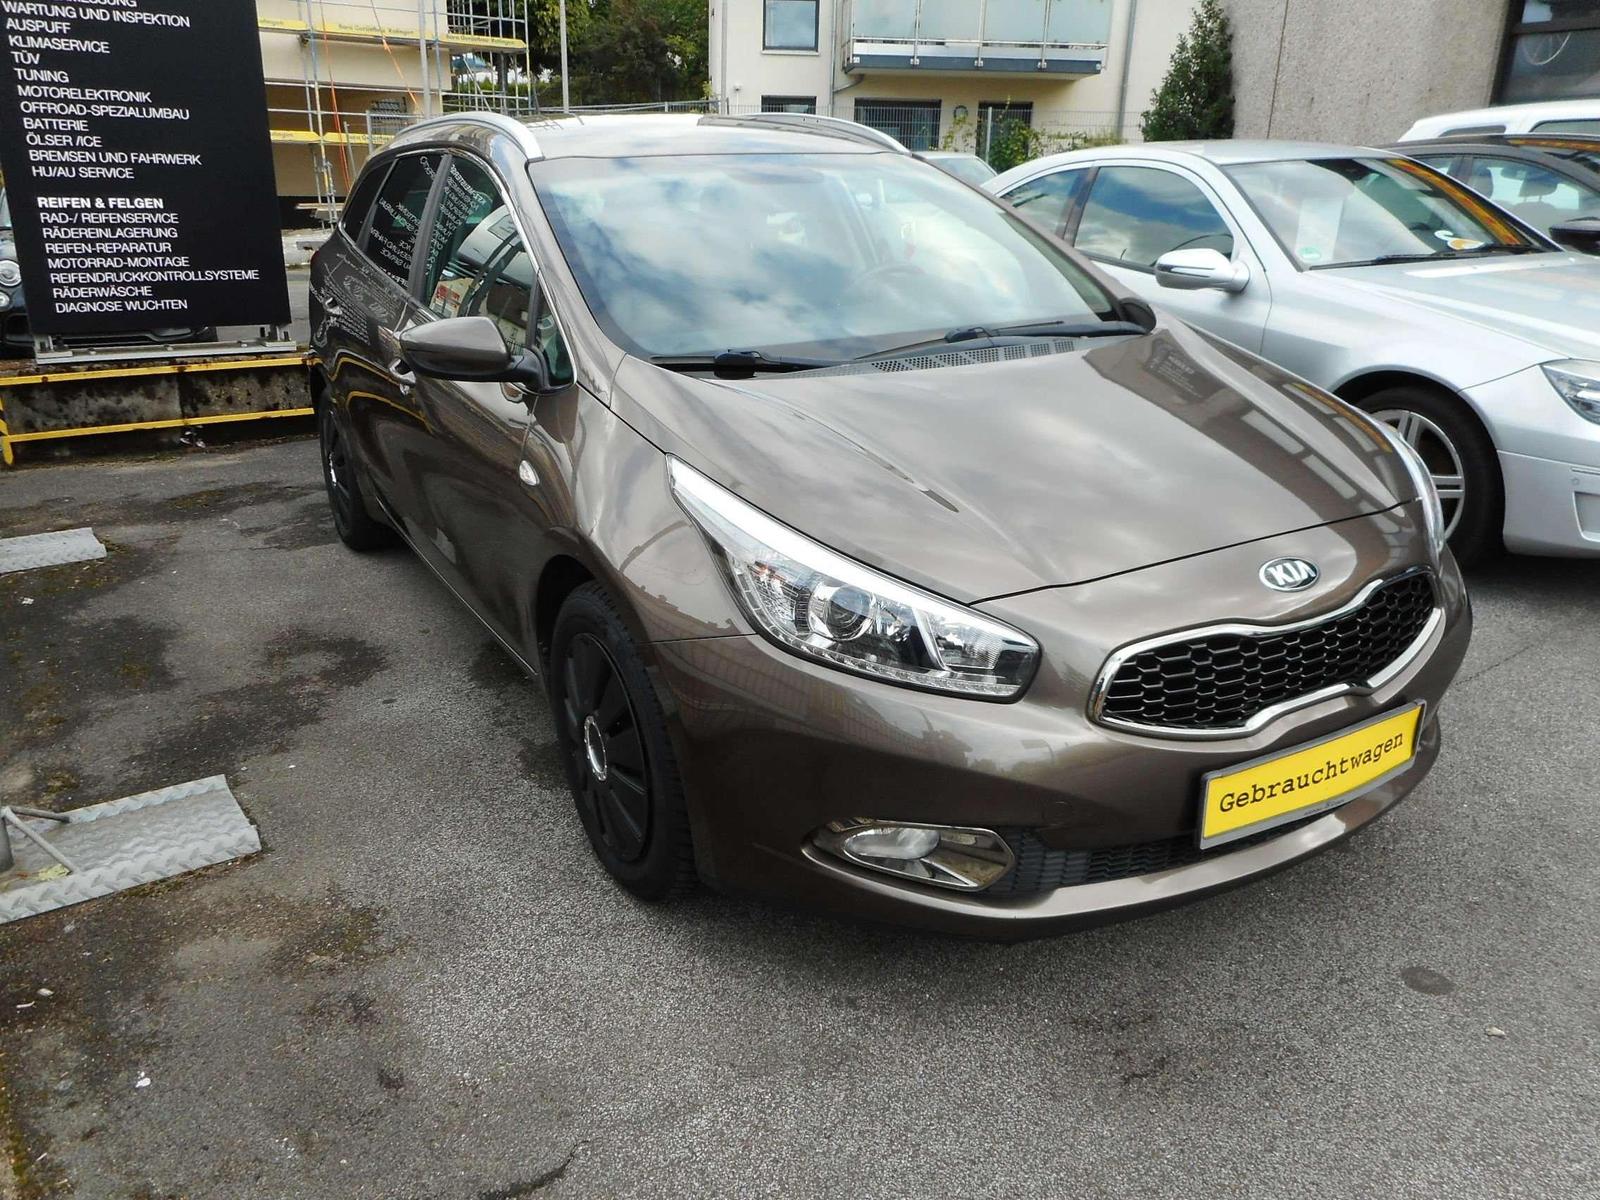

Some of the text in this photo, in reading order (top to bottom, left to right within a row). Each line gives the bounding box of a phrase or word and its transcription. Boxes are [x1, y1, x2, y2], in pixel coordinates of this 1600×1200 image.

[2, 0, 77, 19] WARTUNG
[80, 8, 110, 21] UND
[113, 11, 190, 27] INSPEKTION
[6, 19, 71, 34] AUSPUFF
[9, 35, 110, 53] KLIMASERVICE
[11, 50, 40, 64] TÜV
[14, 68, 69, 83] TUNING
[18, 86, 151, 103] MOTORELEKTRONIK
[20, 101, 189, 120] OFFROAD-SPEZIALUMBAU
[23, 118, 88, 131] BATTERIE
[29, 150, 201, 165] BREMSEN UND FAHRWERK
[32, 166, 134, 179] HU/AU SERVICE
[37, 197, 163, 209] REIFEN & FELGEN
[82, 213, 179, 223] REIFENSERVICE
[43, 227, 178, 239] RÄDEREINLAGERUNG
[45, 242, 172, 254] REIFEN-REPARATUR
[48, 257, 189, 269] MOTORRAD-MONTAGE
[51, 269, 259, 284] REIFENDRUCKKONTROLLSYSTEME
[53, 285, 152, 298] RÄDERWÄSCHE
[56, 300, 187, 314] DIAGNOSE WUCHTEN
[1269, 561, 1316, 587] KIA
[1220, 733, 1403, 812] Gebrauchtwagen
